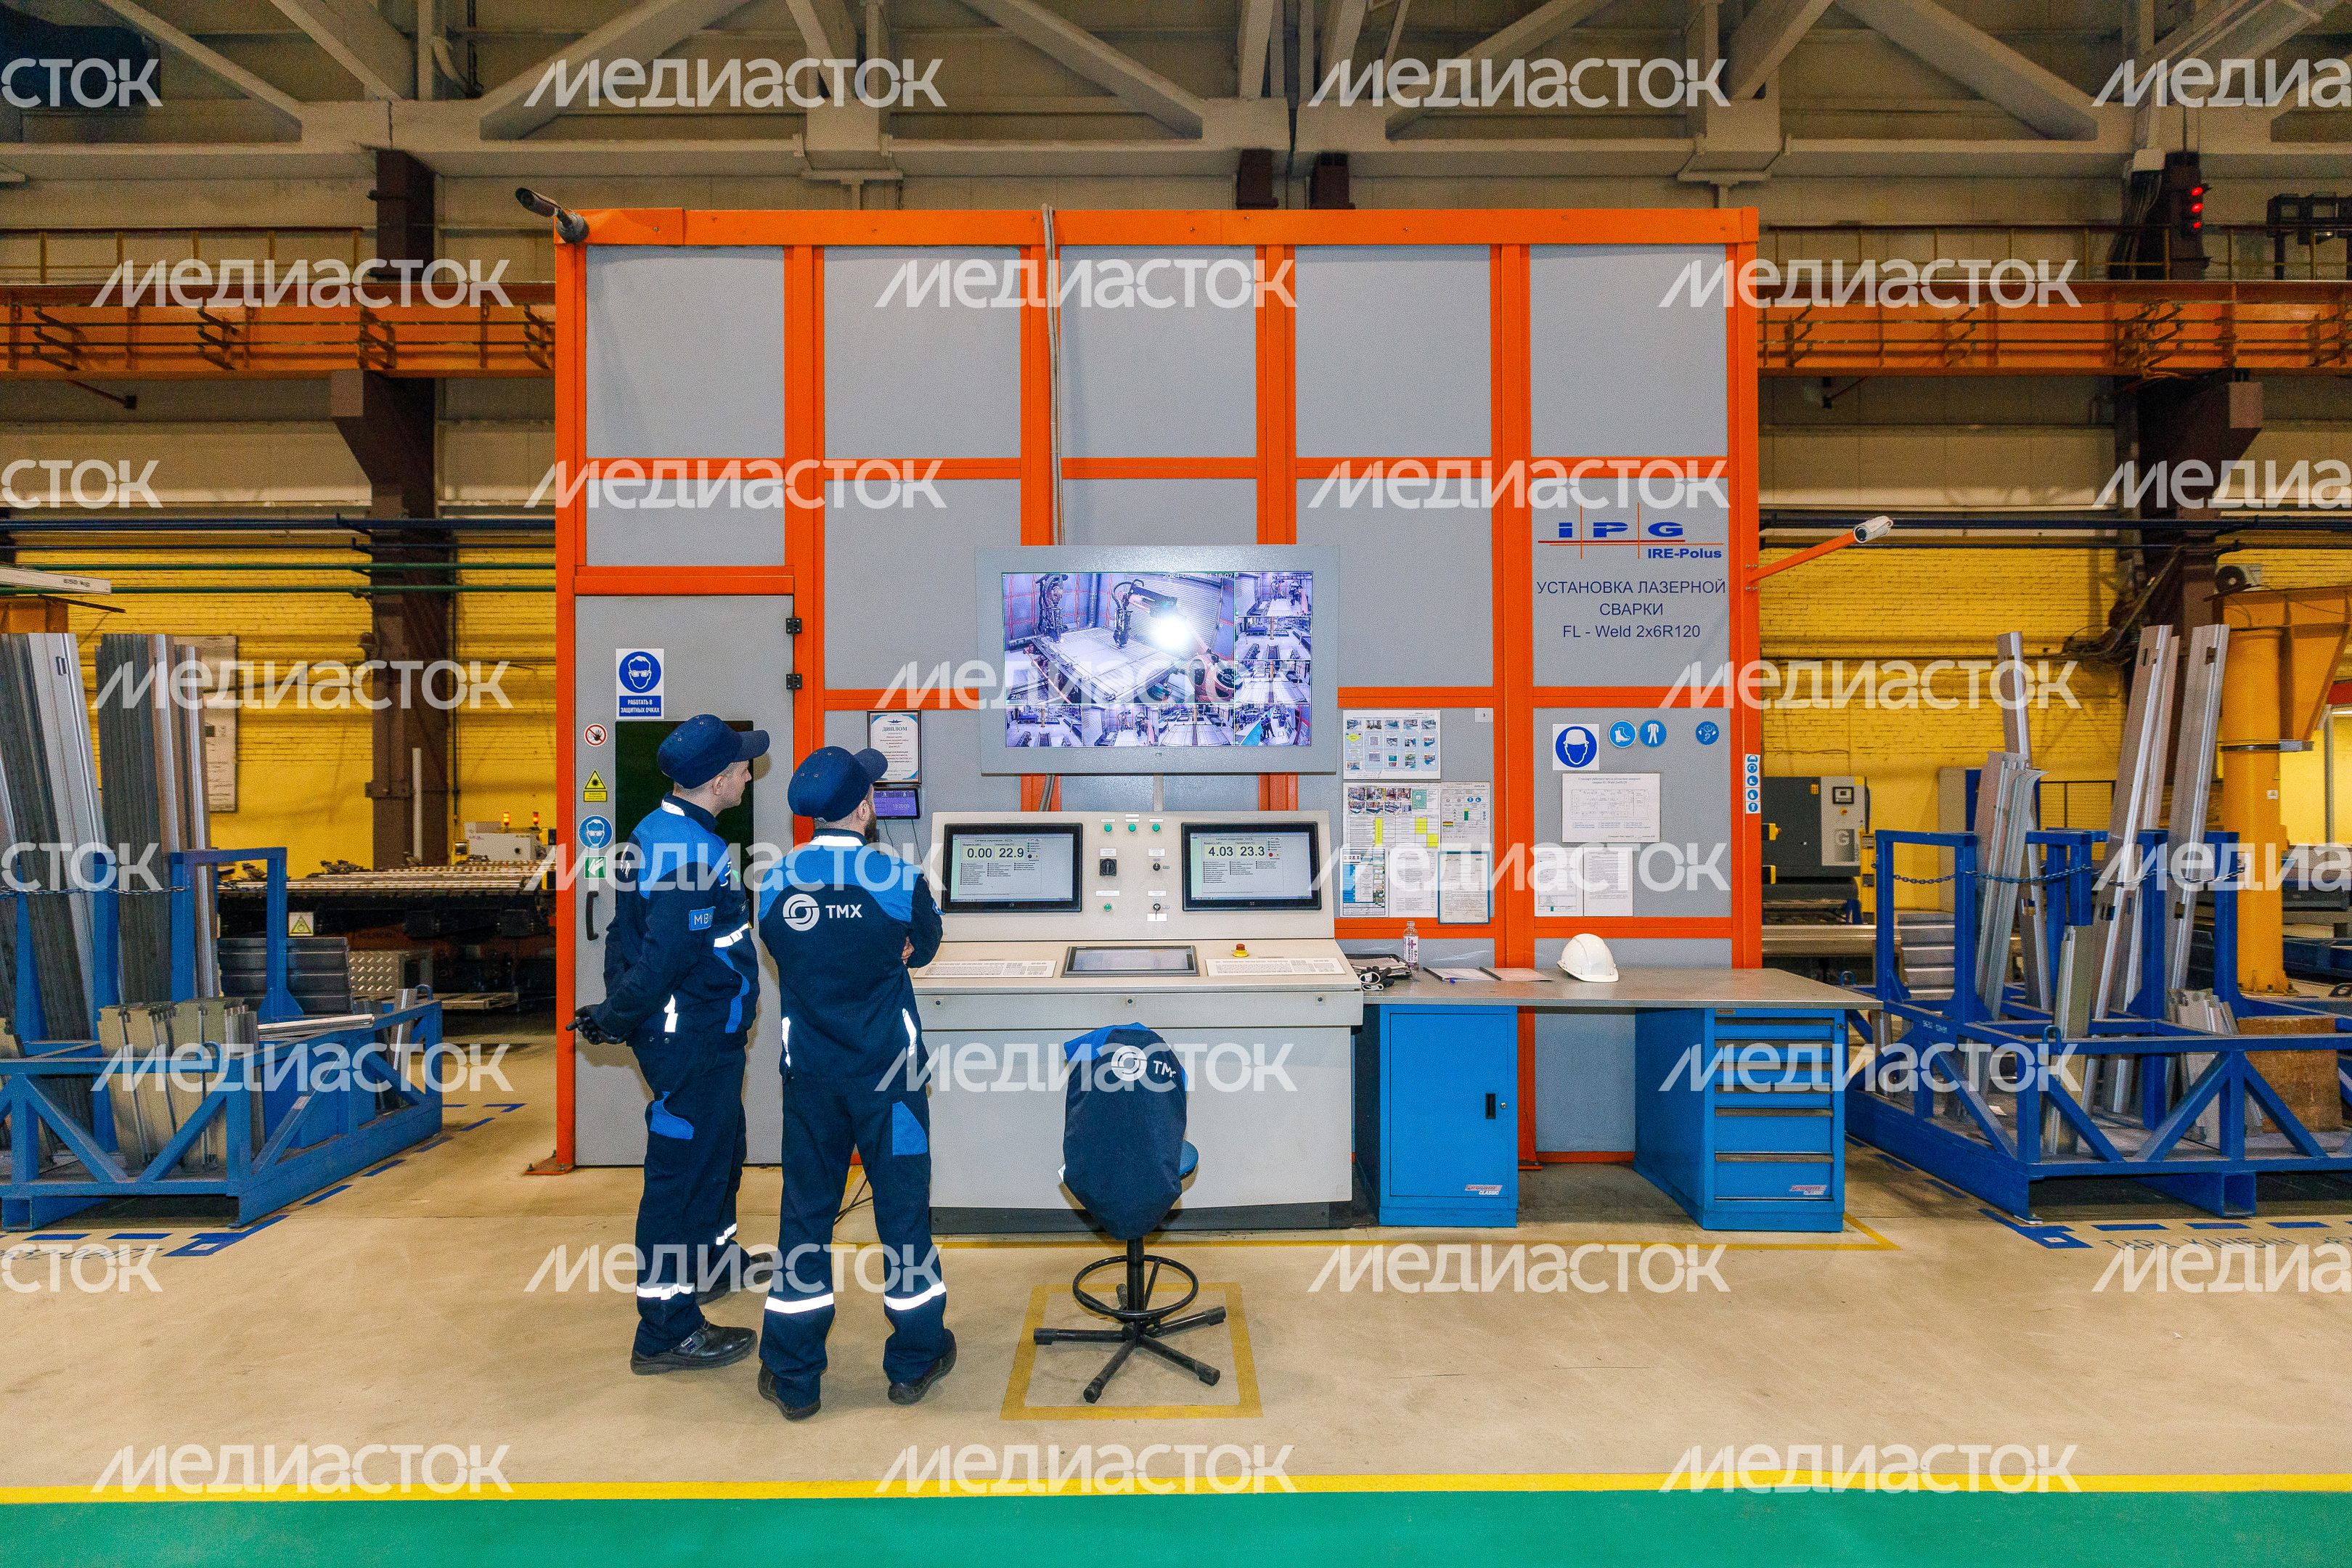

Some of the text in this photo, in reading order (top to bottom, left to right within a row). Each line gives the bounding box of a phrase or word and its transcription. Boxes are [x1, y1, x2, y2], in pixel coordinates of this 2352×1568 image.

[1648, 548, 1722, 559] IRE-Polus
[1537, 579, 1726, 594] УСТАНОВКА ЛАЗЕРНОЙ
[1599, 603, 1664, 616] СВАРКИ
[1563, 625, 1581, 637] FL
[1595, 625, 1631, 637] Weld
[1636, 624, 1701, 637] 2x6R120
[967, 848, 992, 858] 0.00
[999, 847, 1024, 858] 22.9
[1208, 846, 1233, 857] 4.03
[1240, 846, 1265, 857] 23.3
[1153, 1060, 1177, 1077] ТМ
